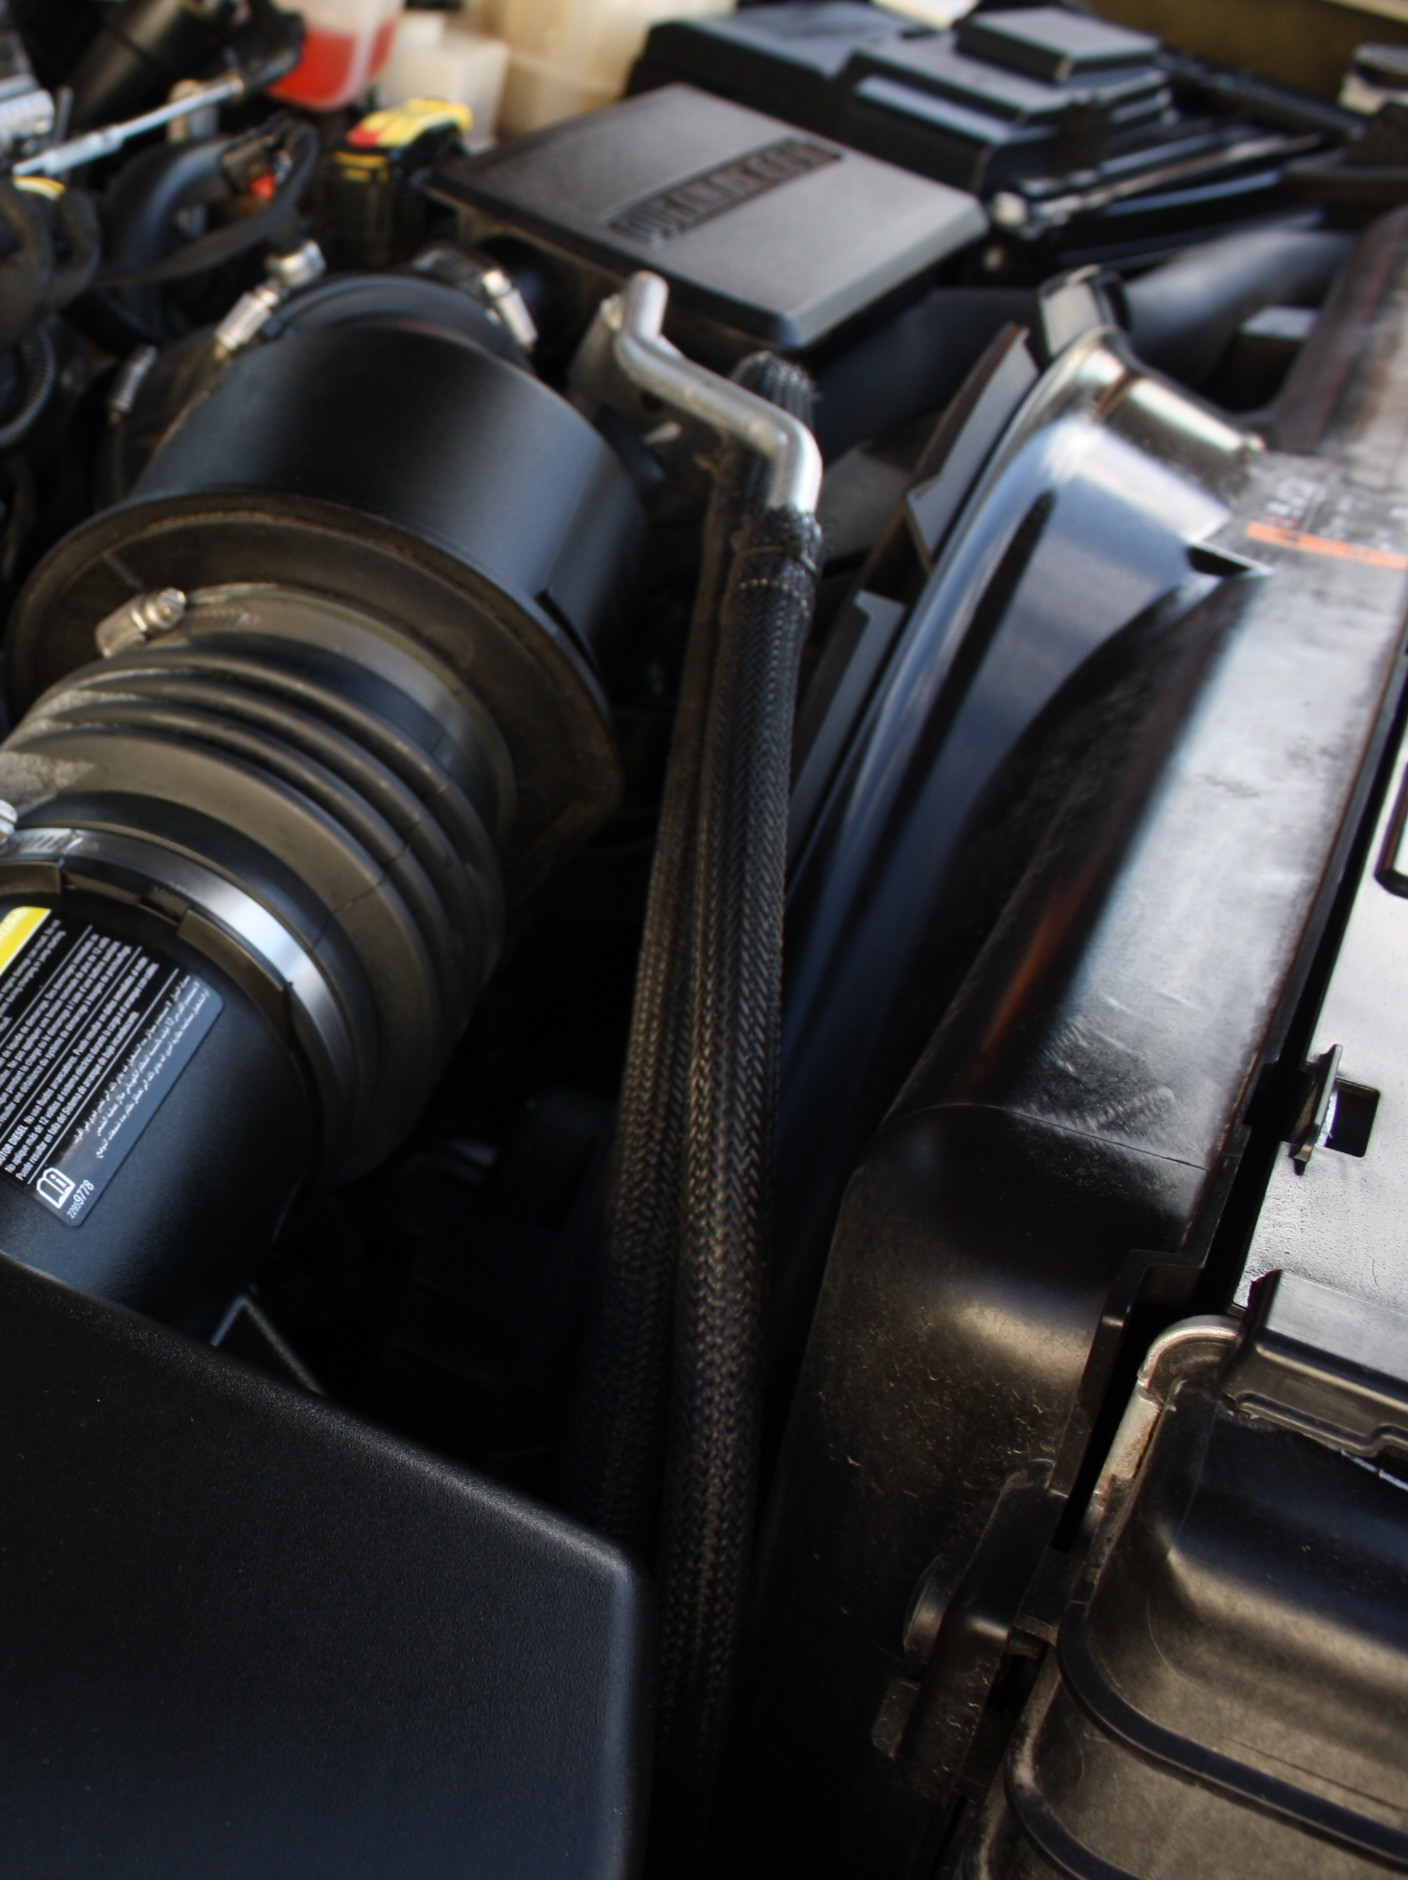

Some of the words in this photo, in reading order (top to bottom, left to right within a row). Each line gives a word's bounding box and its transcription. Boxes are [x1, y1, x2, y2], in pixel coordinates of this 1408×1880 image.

[1, 1049, 11, 1057] de
[20, 1025, 29, 1033] de
[6, 1059, 18, 1068] Ne
[14, 1050, 25, 1061] pas
[21, 1027, 42, 1051] appliquer
[4, 1070, 24, 1093] pendant
[24, 1047, 41, 1066] charge
[37, 1040, 47, 1048] ou
[12, 1091, 24, 1103] une
[39, 1057, 49, 1066] du
[59, 1029, 69, 1038] de
[97, 1056, 107, 1065] de
[82, 1063, 102, 1087] arranque
[8, 1124, 28, 1145] DIESEL
[23, 1115, 34, 1124] No
[30, 1104, 42, 1116] use
[36, 1088, 54, 1106] fluidos
[72, 1038, 89, 1055] Puede
[77, 1085, 87, 1094] de
[61, 1092, 82, 1115] Sistema
[4, 1163, 16, 1173] No
[11, 1144, 29, 1165] aplique
[25, 1132, 38, 1146] más
[33, 1124, 43, 1133] de
[38, 1116, 49, 1125] 12
[44, 1100, 60, 1118] voltios
[56, 1093, 64, 1102] al
[60, 1074, 79, 1096] sistema
[47, 1122, 61, 1135] falla
[56, 1112, 68, 1124] del
[43, 1133, 53, 1142] en
[29, 1140, 47, 1163] resultar
[15, 1161, 33, 1180] Puede
